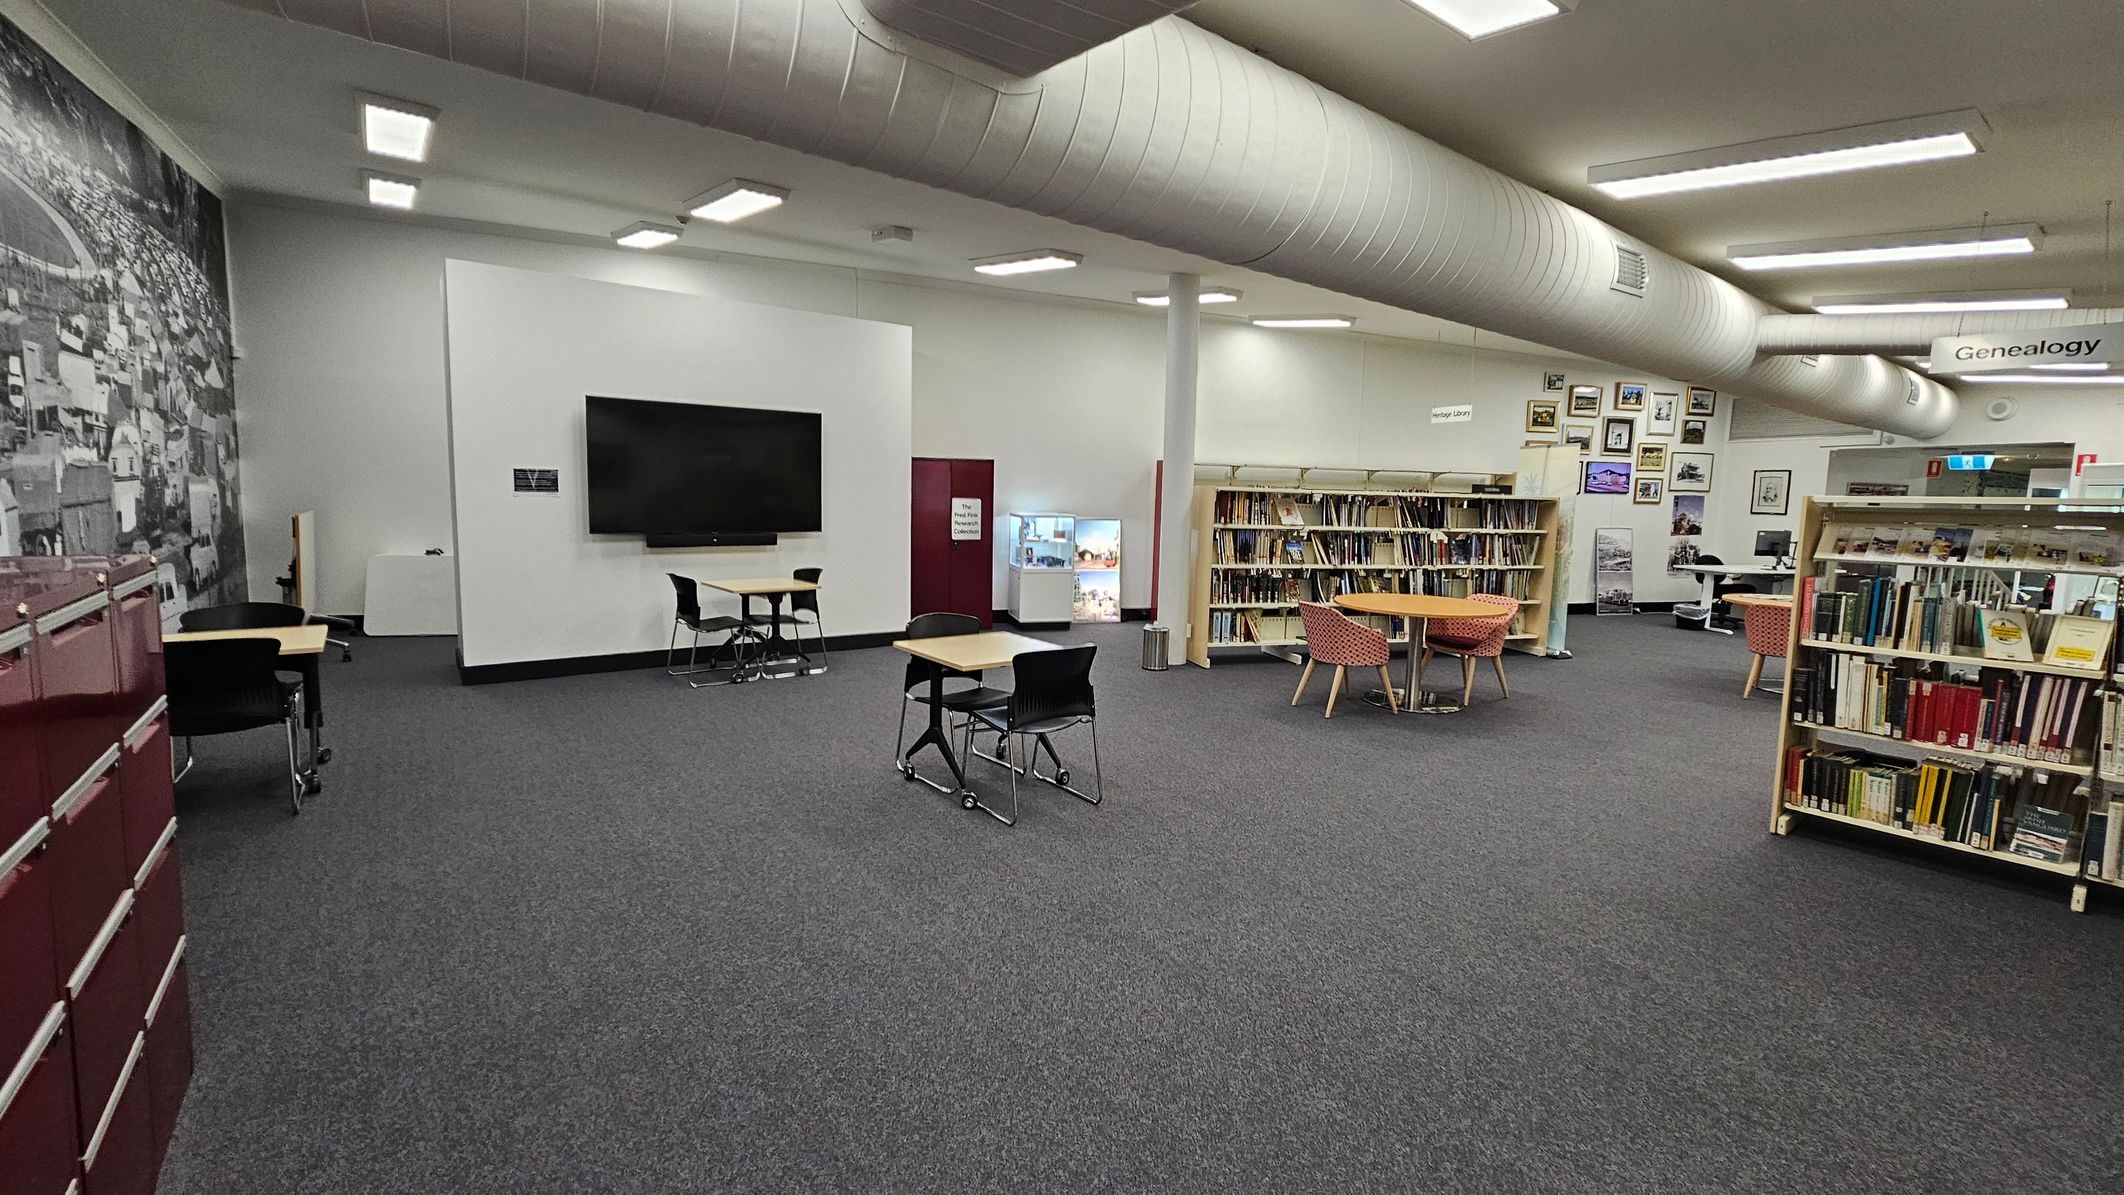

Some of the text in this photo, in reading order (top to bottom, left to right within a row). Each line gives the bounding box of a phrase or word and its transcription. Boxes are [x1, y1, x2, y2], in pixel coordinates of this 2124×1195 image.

[1955, 338, 2102, 361] Genealogy
[1432, 410, 1471, 419] Heritage Library
